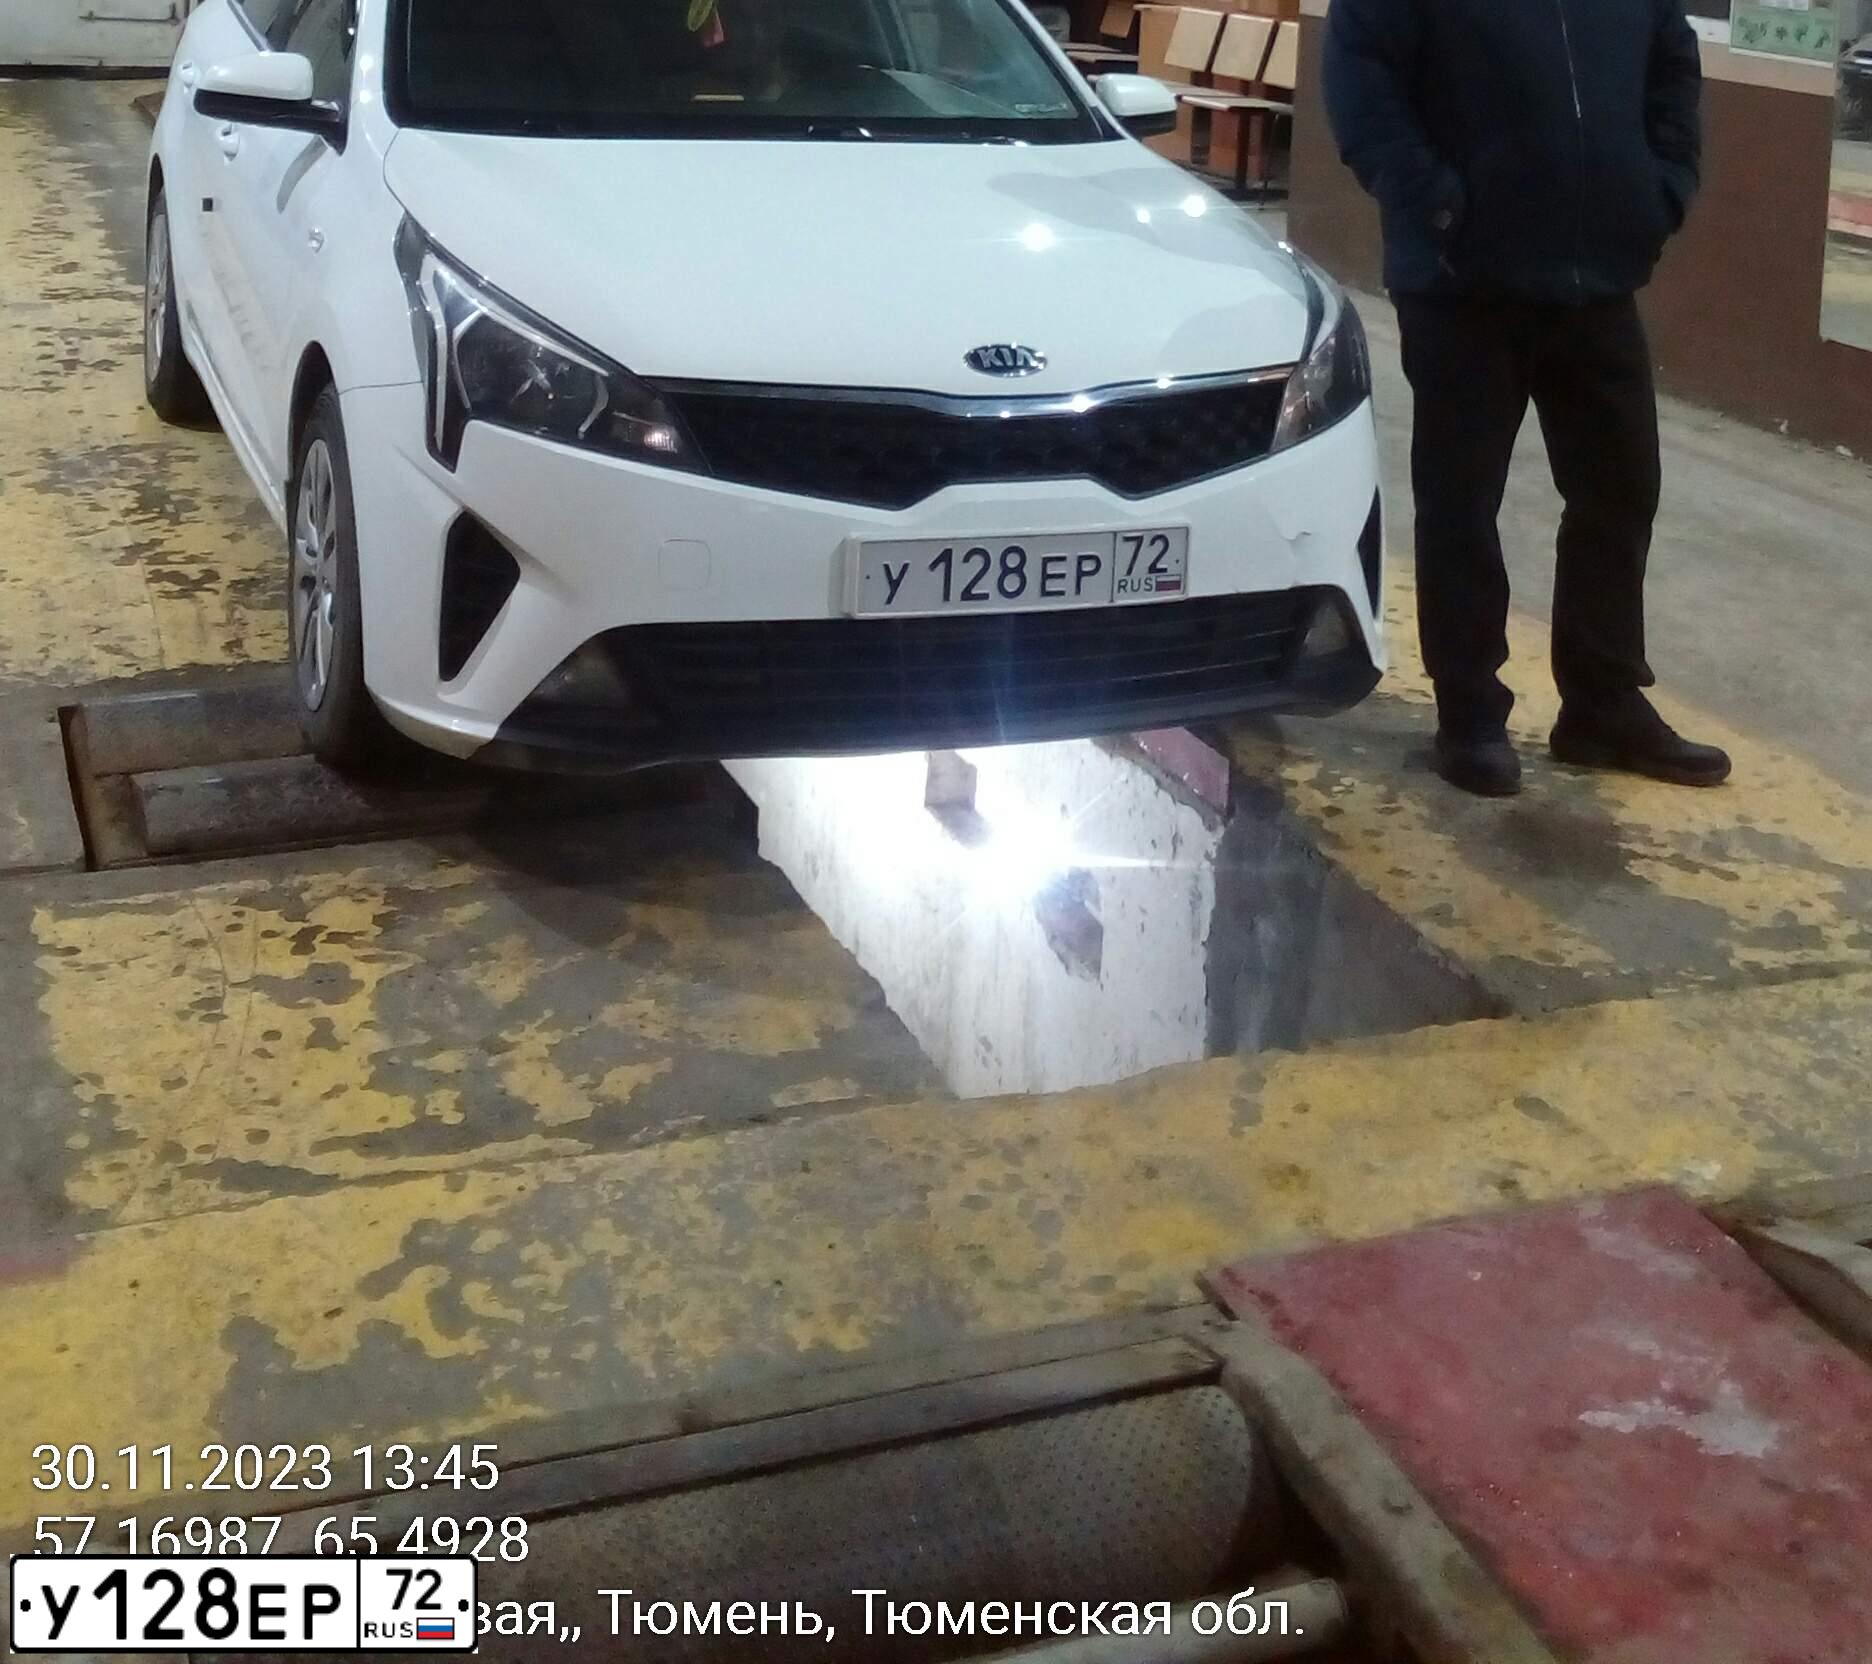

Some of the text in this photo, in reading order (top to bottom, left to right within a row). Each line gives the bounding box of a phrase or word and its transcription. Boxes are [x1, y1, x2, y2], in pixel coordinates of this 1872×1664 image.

[974, 345, 1039, 370] KIA
[1121, 533, 1171, 576] 72
[1117, 576, 1154, 593] RUS
